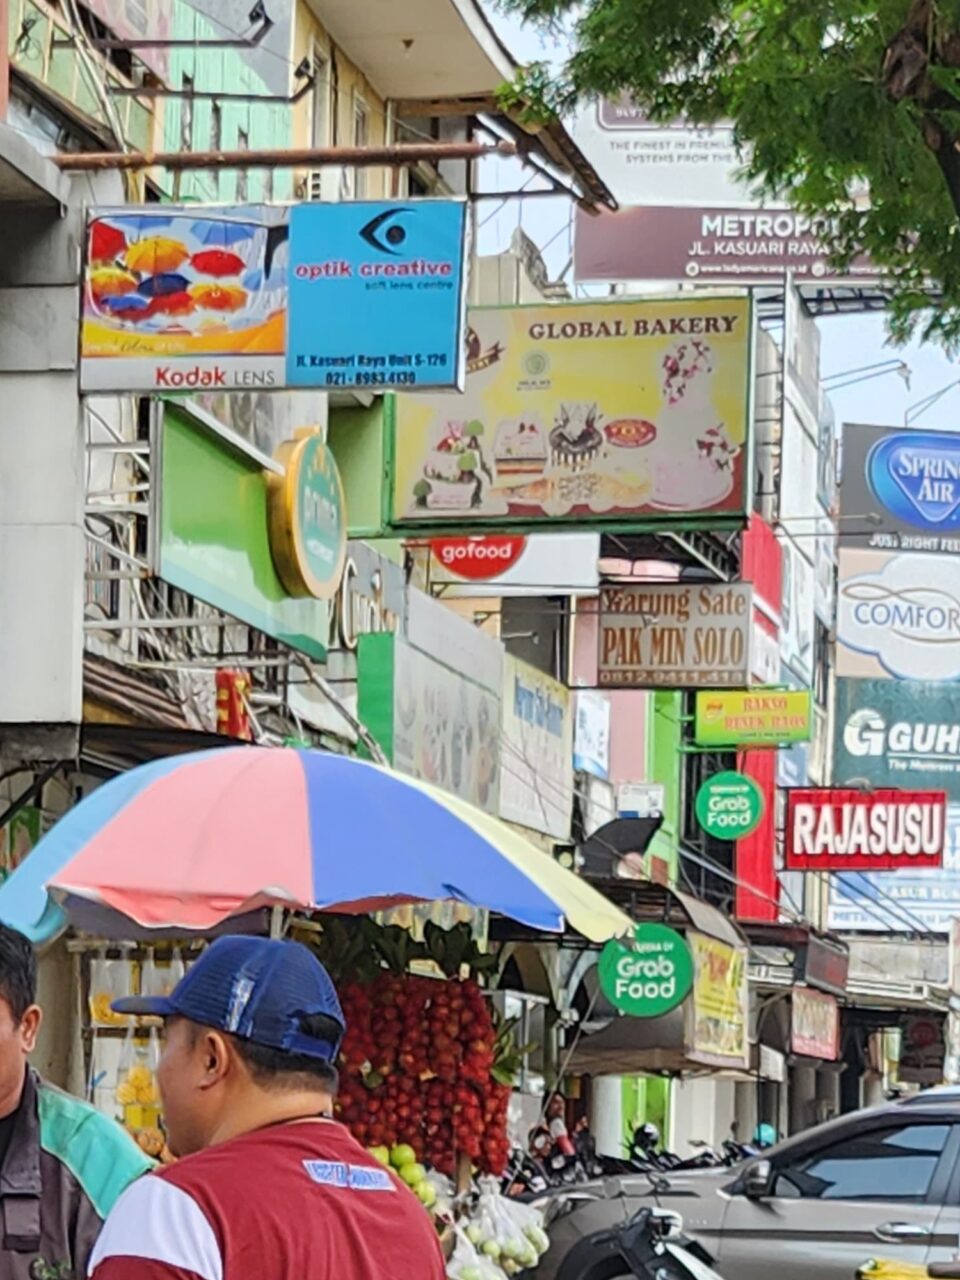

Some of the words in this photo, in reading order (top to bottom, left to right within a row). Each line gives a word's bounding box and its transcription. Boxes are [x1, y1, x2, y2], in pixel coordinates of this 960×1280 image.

[714, 241, 784, 255] KASUARI
[788, 242, 831, 255] RAYA
[296, 262, 352, 280] optik
[360, 260, 453, 277] creative
[529, 321, 628, 340] GLOBAL
[634, 315, 738, 336] BAKERY
[155, 367, 226, 386] Kodak
[233, 369, 275, 385] LENS
[898, 450, 960, 481] SPRIN
[917, 476, 955, 503] AIR
[442, 543, 512, 563] gofood
[698, 587, 746, 616] Sate
[602, 627, 641, 666] PAK
[650, 628, 686, 666] MIN
[693, 627, 744, 667] SOLO
[888, 722, 960, 753] GUH
[708, 796, 749, 811] Grab
[707, 810, 751, 827] Food
[793, 804, 940, 855] RAJASUSU
[617, 957, 674, 978] Grab
[616, 977, 676, 998] Food
